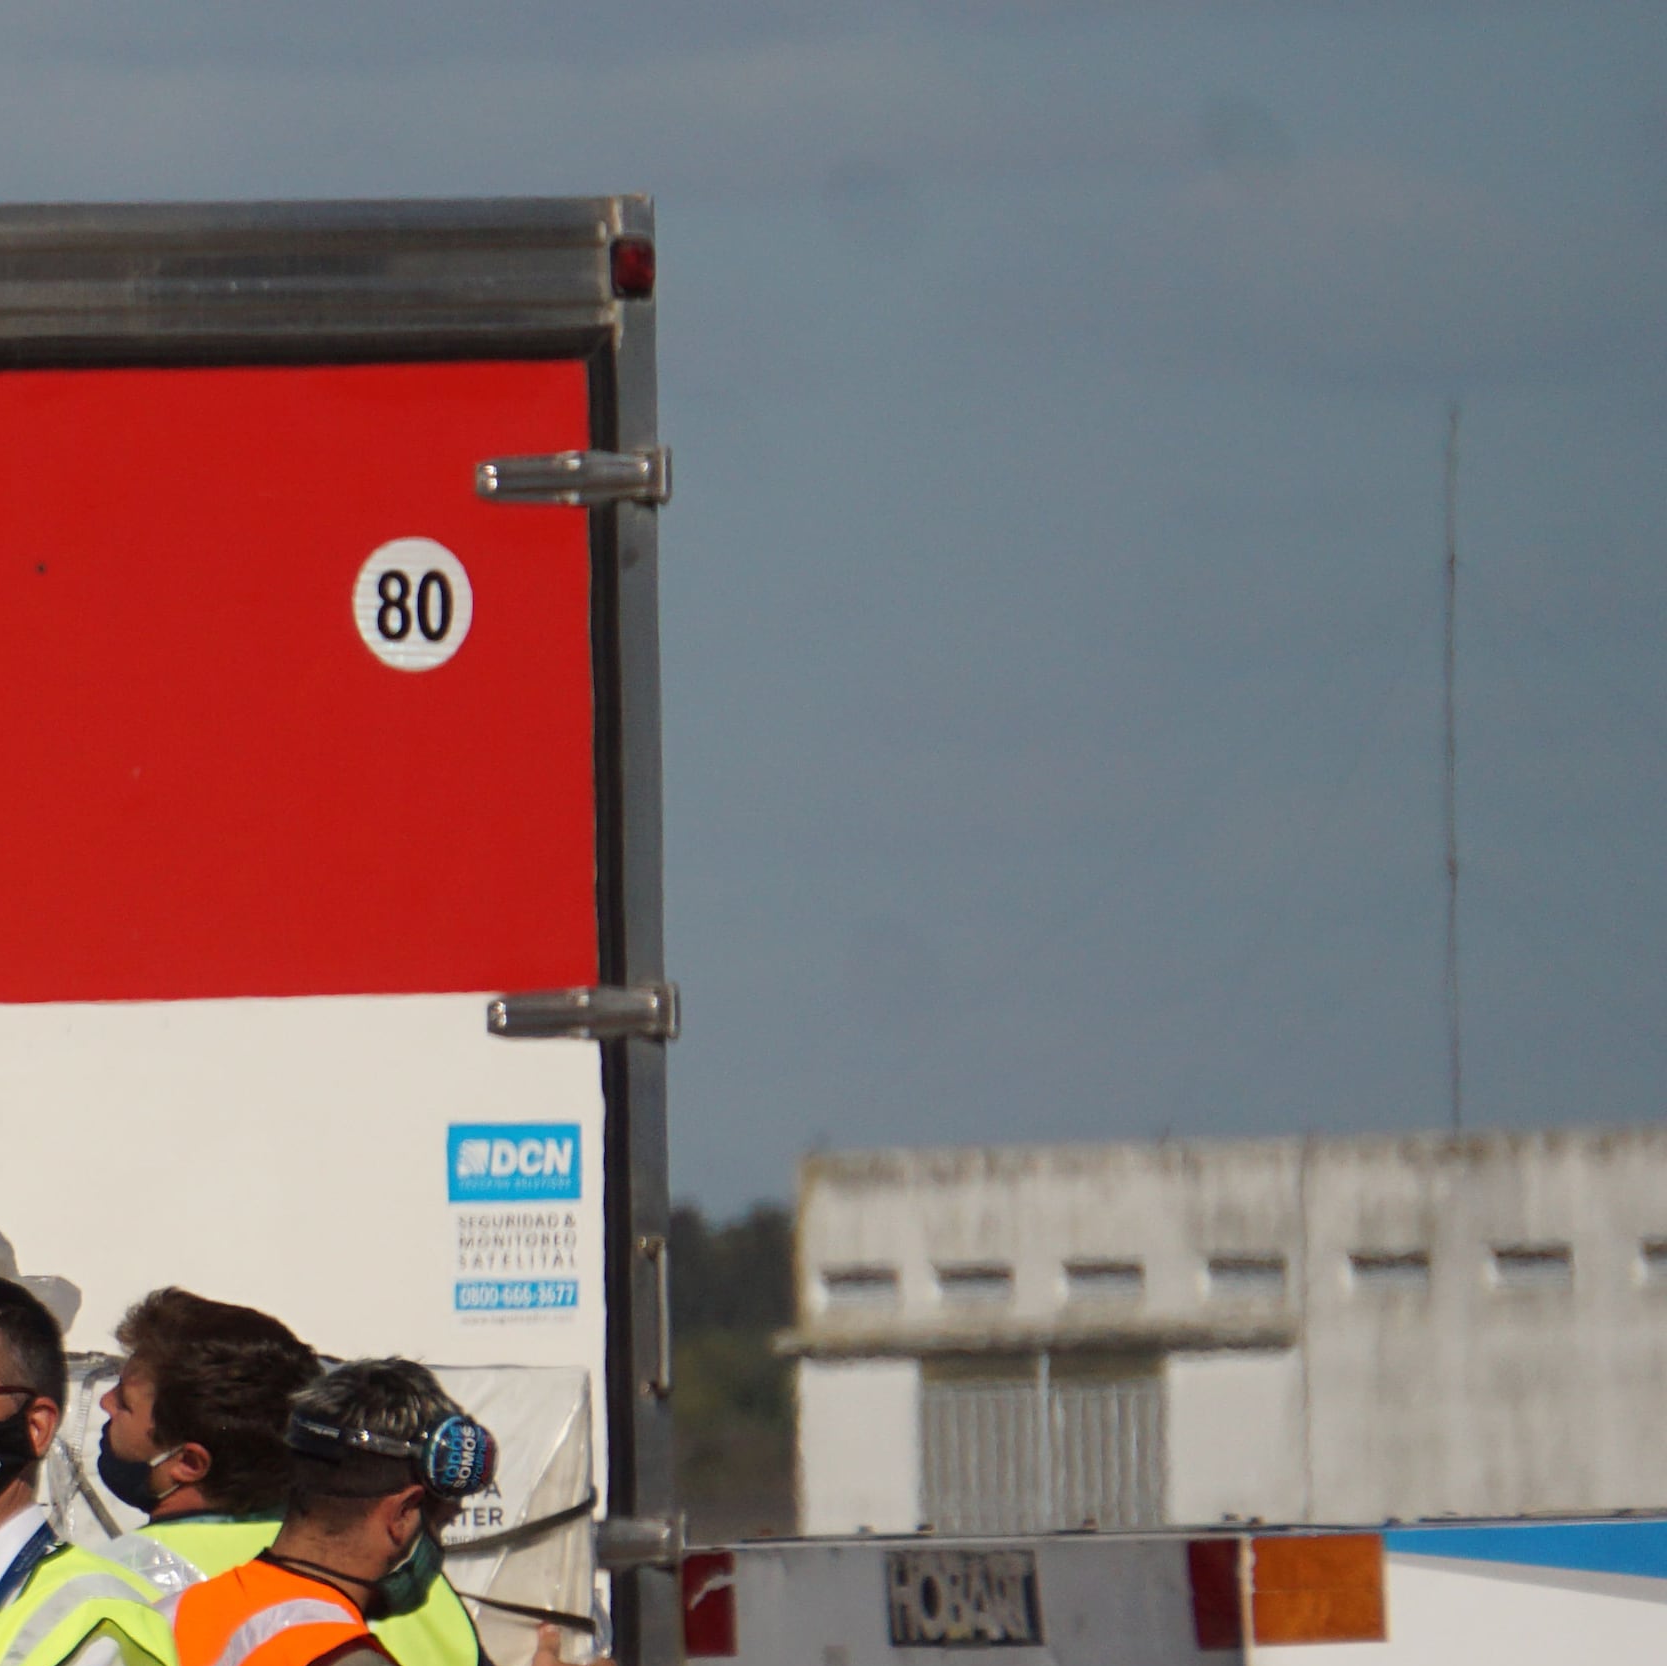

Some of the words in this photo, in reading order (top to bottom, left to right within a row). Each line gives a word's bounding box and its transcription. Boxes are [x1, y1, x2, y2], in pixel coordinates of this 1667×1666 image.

[376, 568, 454, 643] 80
[489, 1137, 573, 1177] DCN
[458, 1213, 560, 1229] SEGURIDAD
[458, 1231, 577, 1248] MONITOREO
[458, 1251, 575, 1270] SATELITAL
[452, 1425, 477, 1489] SOMOS
[889, 1551, 1035, 1643] HOBART
